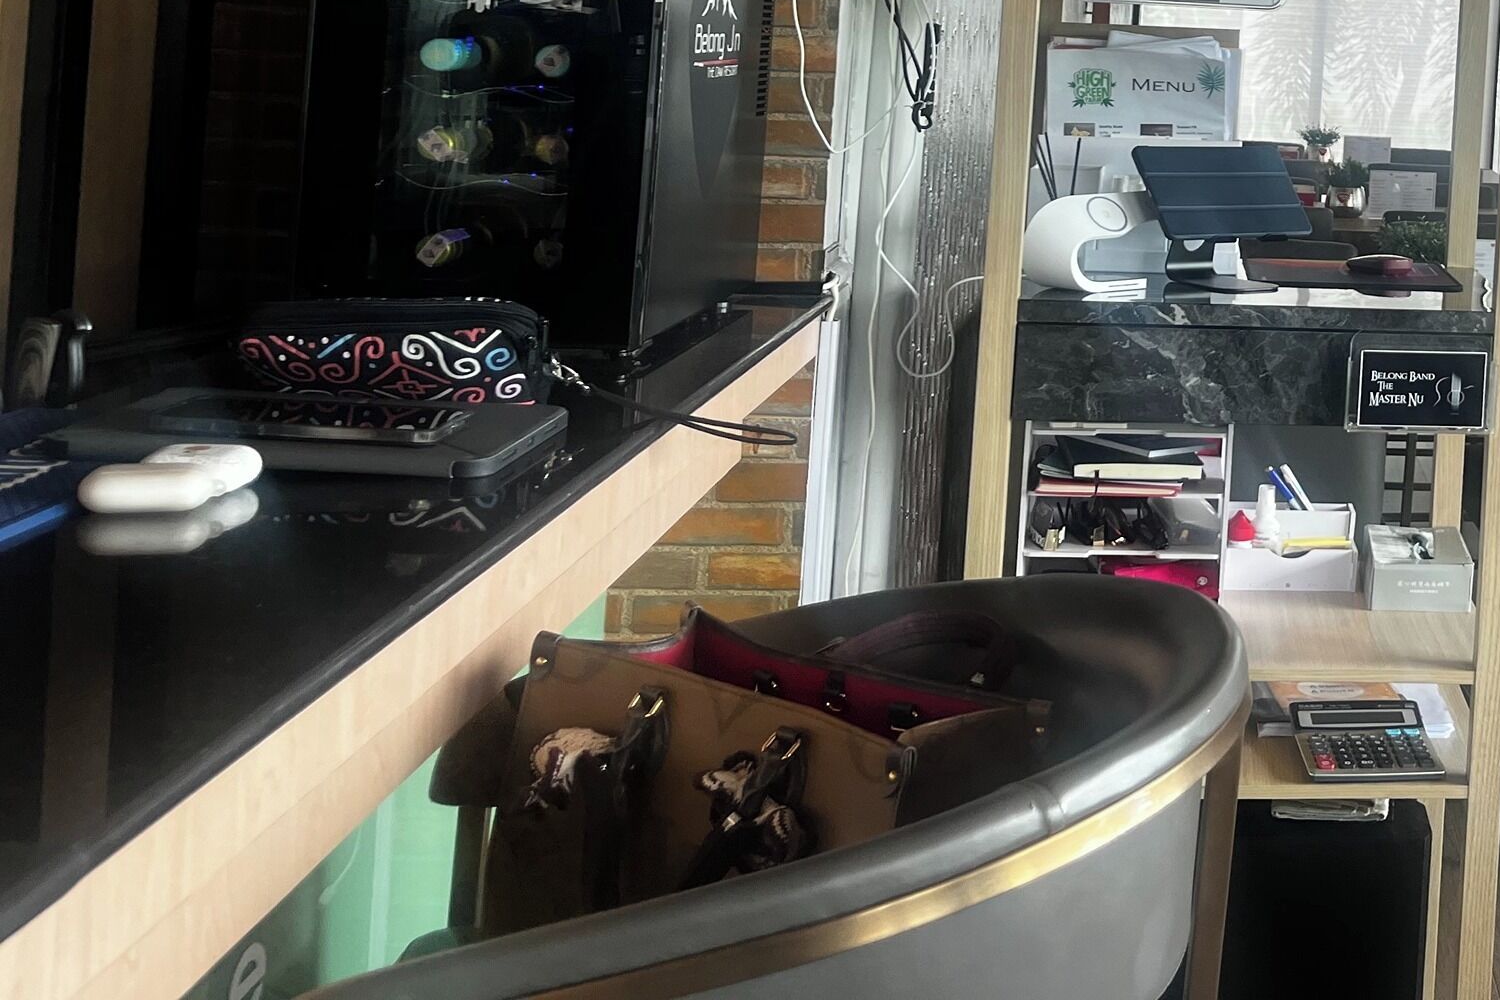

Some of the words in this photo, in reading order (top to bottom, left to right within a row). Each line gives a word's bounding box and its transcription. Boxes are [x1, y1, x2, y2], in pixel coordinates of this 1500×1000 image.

[1076, 85, 1110, 98] GREEN
[1371, 370, 1408, 382] BELONG
[1409, 370, 1436, 382] BAND
[1377, 380, 1394, 392] THE
[1369, 391, 1407, 407] MASTER
[1407, 392, 1425, 407] NU
